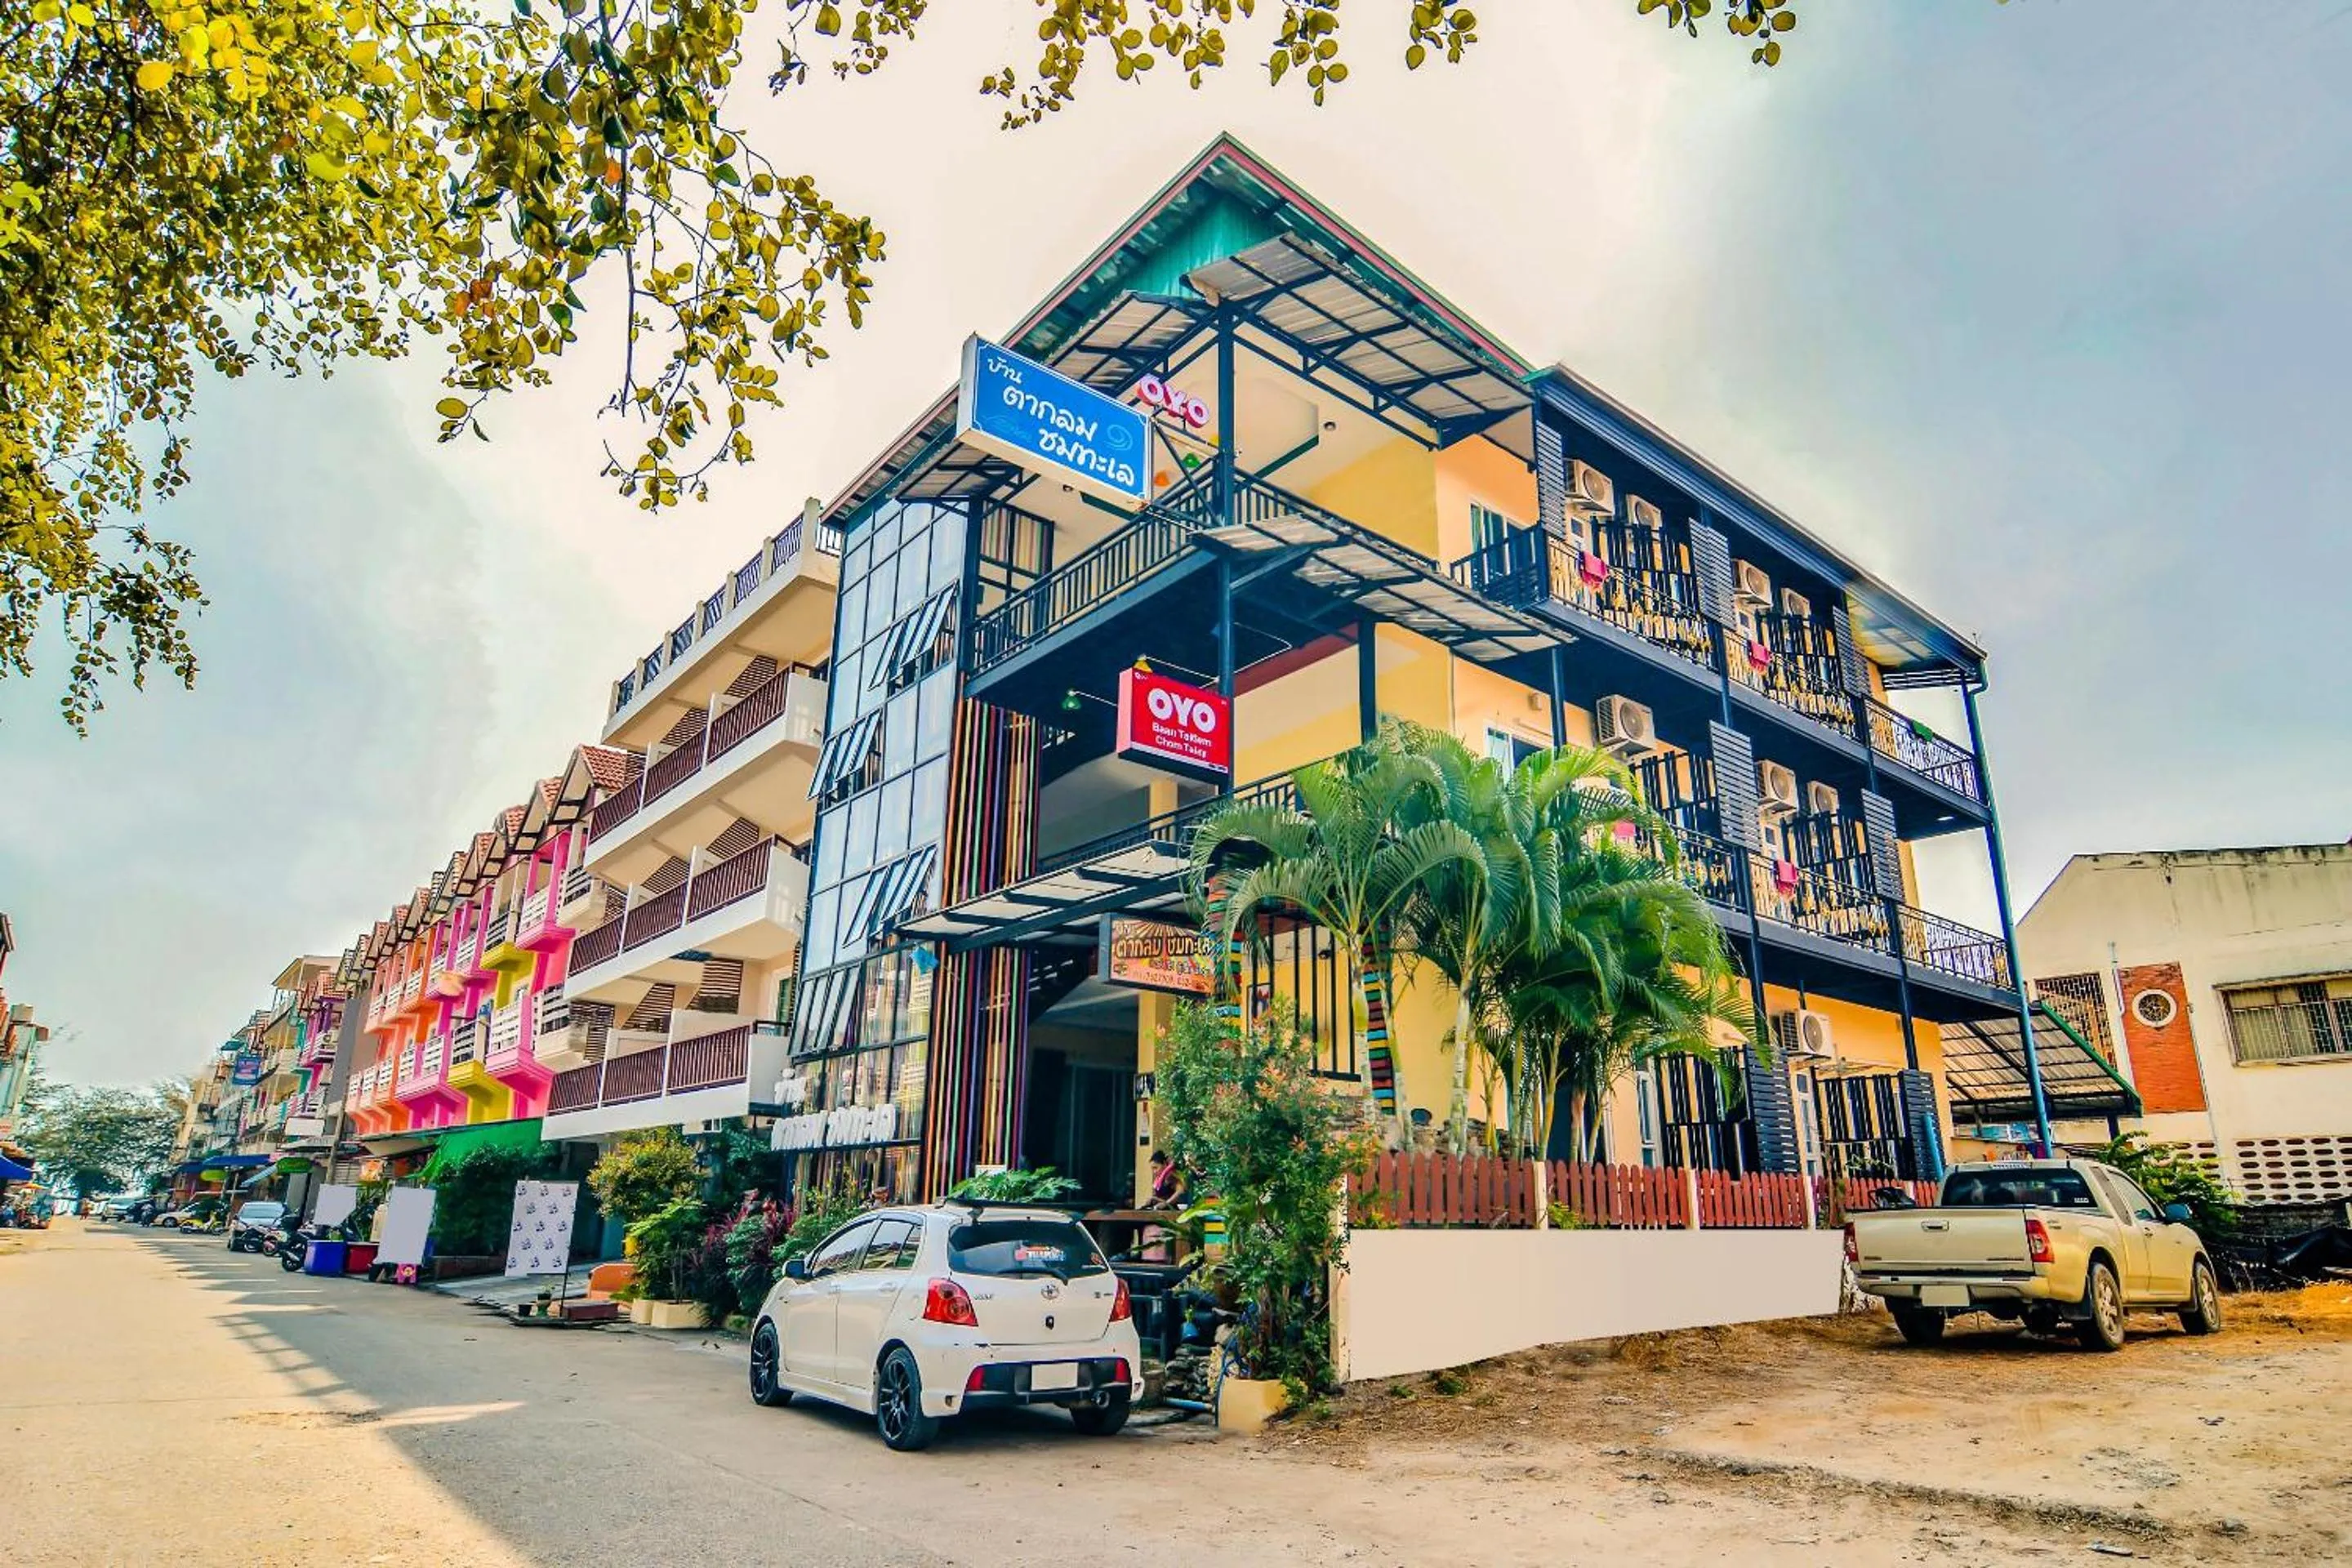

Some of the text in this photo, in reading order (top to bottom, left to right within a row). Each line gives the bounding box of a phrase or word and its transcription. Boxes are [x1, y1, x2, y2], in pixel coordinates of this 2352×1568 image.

[987, 357, 1022, 384] บ้าน
[1003, 385, 1098, 441] ตากลม
[1138, 374, 1209, 427] OYO
[1038, 427, 1135, 487] ชมทะเล
[1147, 688, 1216, 733] OYO
[1156, 737, 1183, 750] Chom
